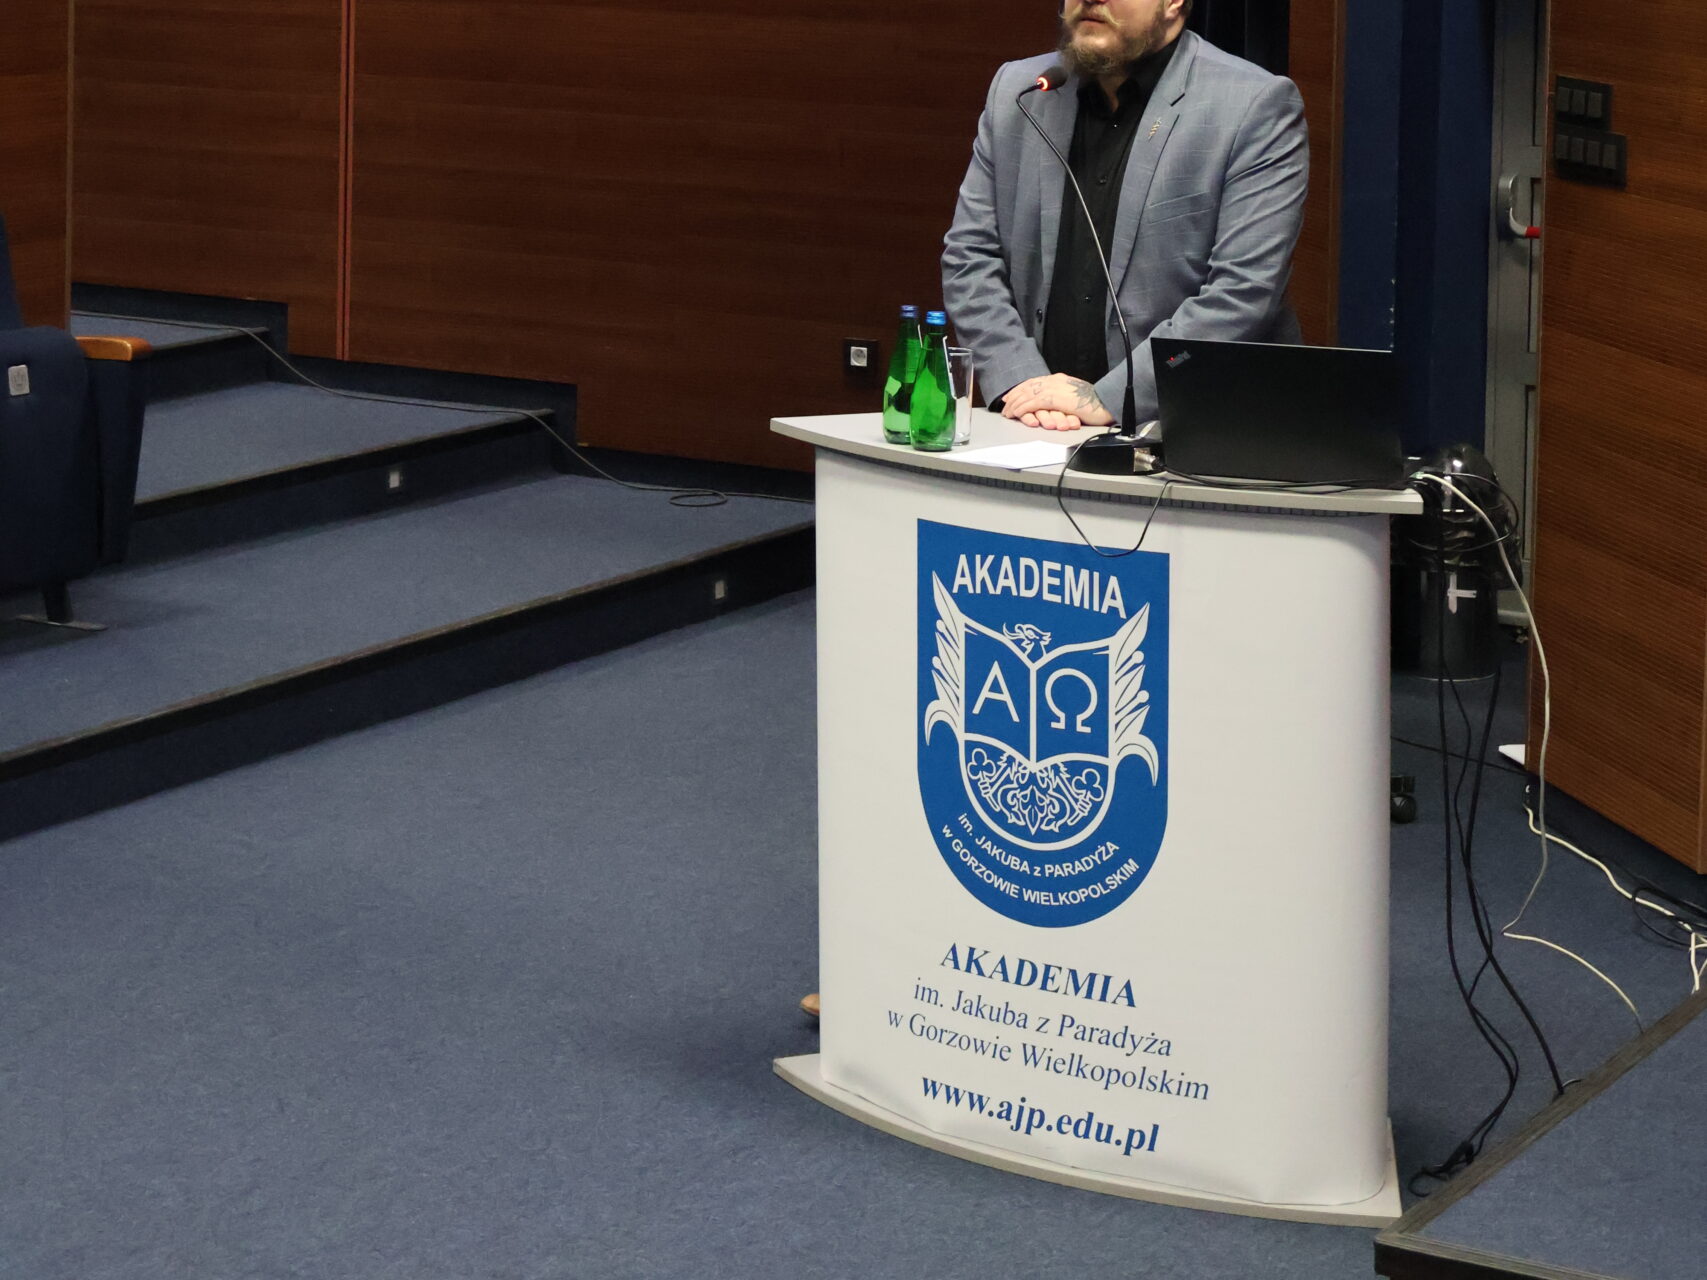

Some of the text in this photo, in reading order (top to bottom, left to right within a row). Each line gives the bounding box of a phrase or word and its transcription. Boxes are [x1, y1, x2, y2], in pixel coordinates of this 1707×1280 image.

[952, 553, 1127, 619] AKADEMIA
[1045, 667, 1098, 733] Ω
[942, 824, 1140, 906] w GORZOWIE WIELKOPOLSKIM
[957, 812, 1120, 878] im. JAKUBA z PARADYŻA
[940, 942, 1137, 1008] AKADEMIA
[914, 977, 1172, 1057] im. Jakuba z Paradyża
[888, 1010, 1210, 1100] w Gorzowie Wielkopolskim
[922, 1077, 1160, 1156] www.ajp.edu.pl
